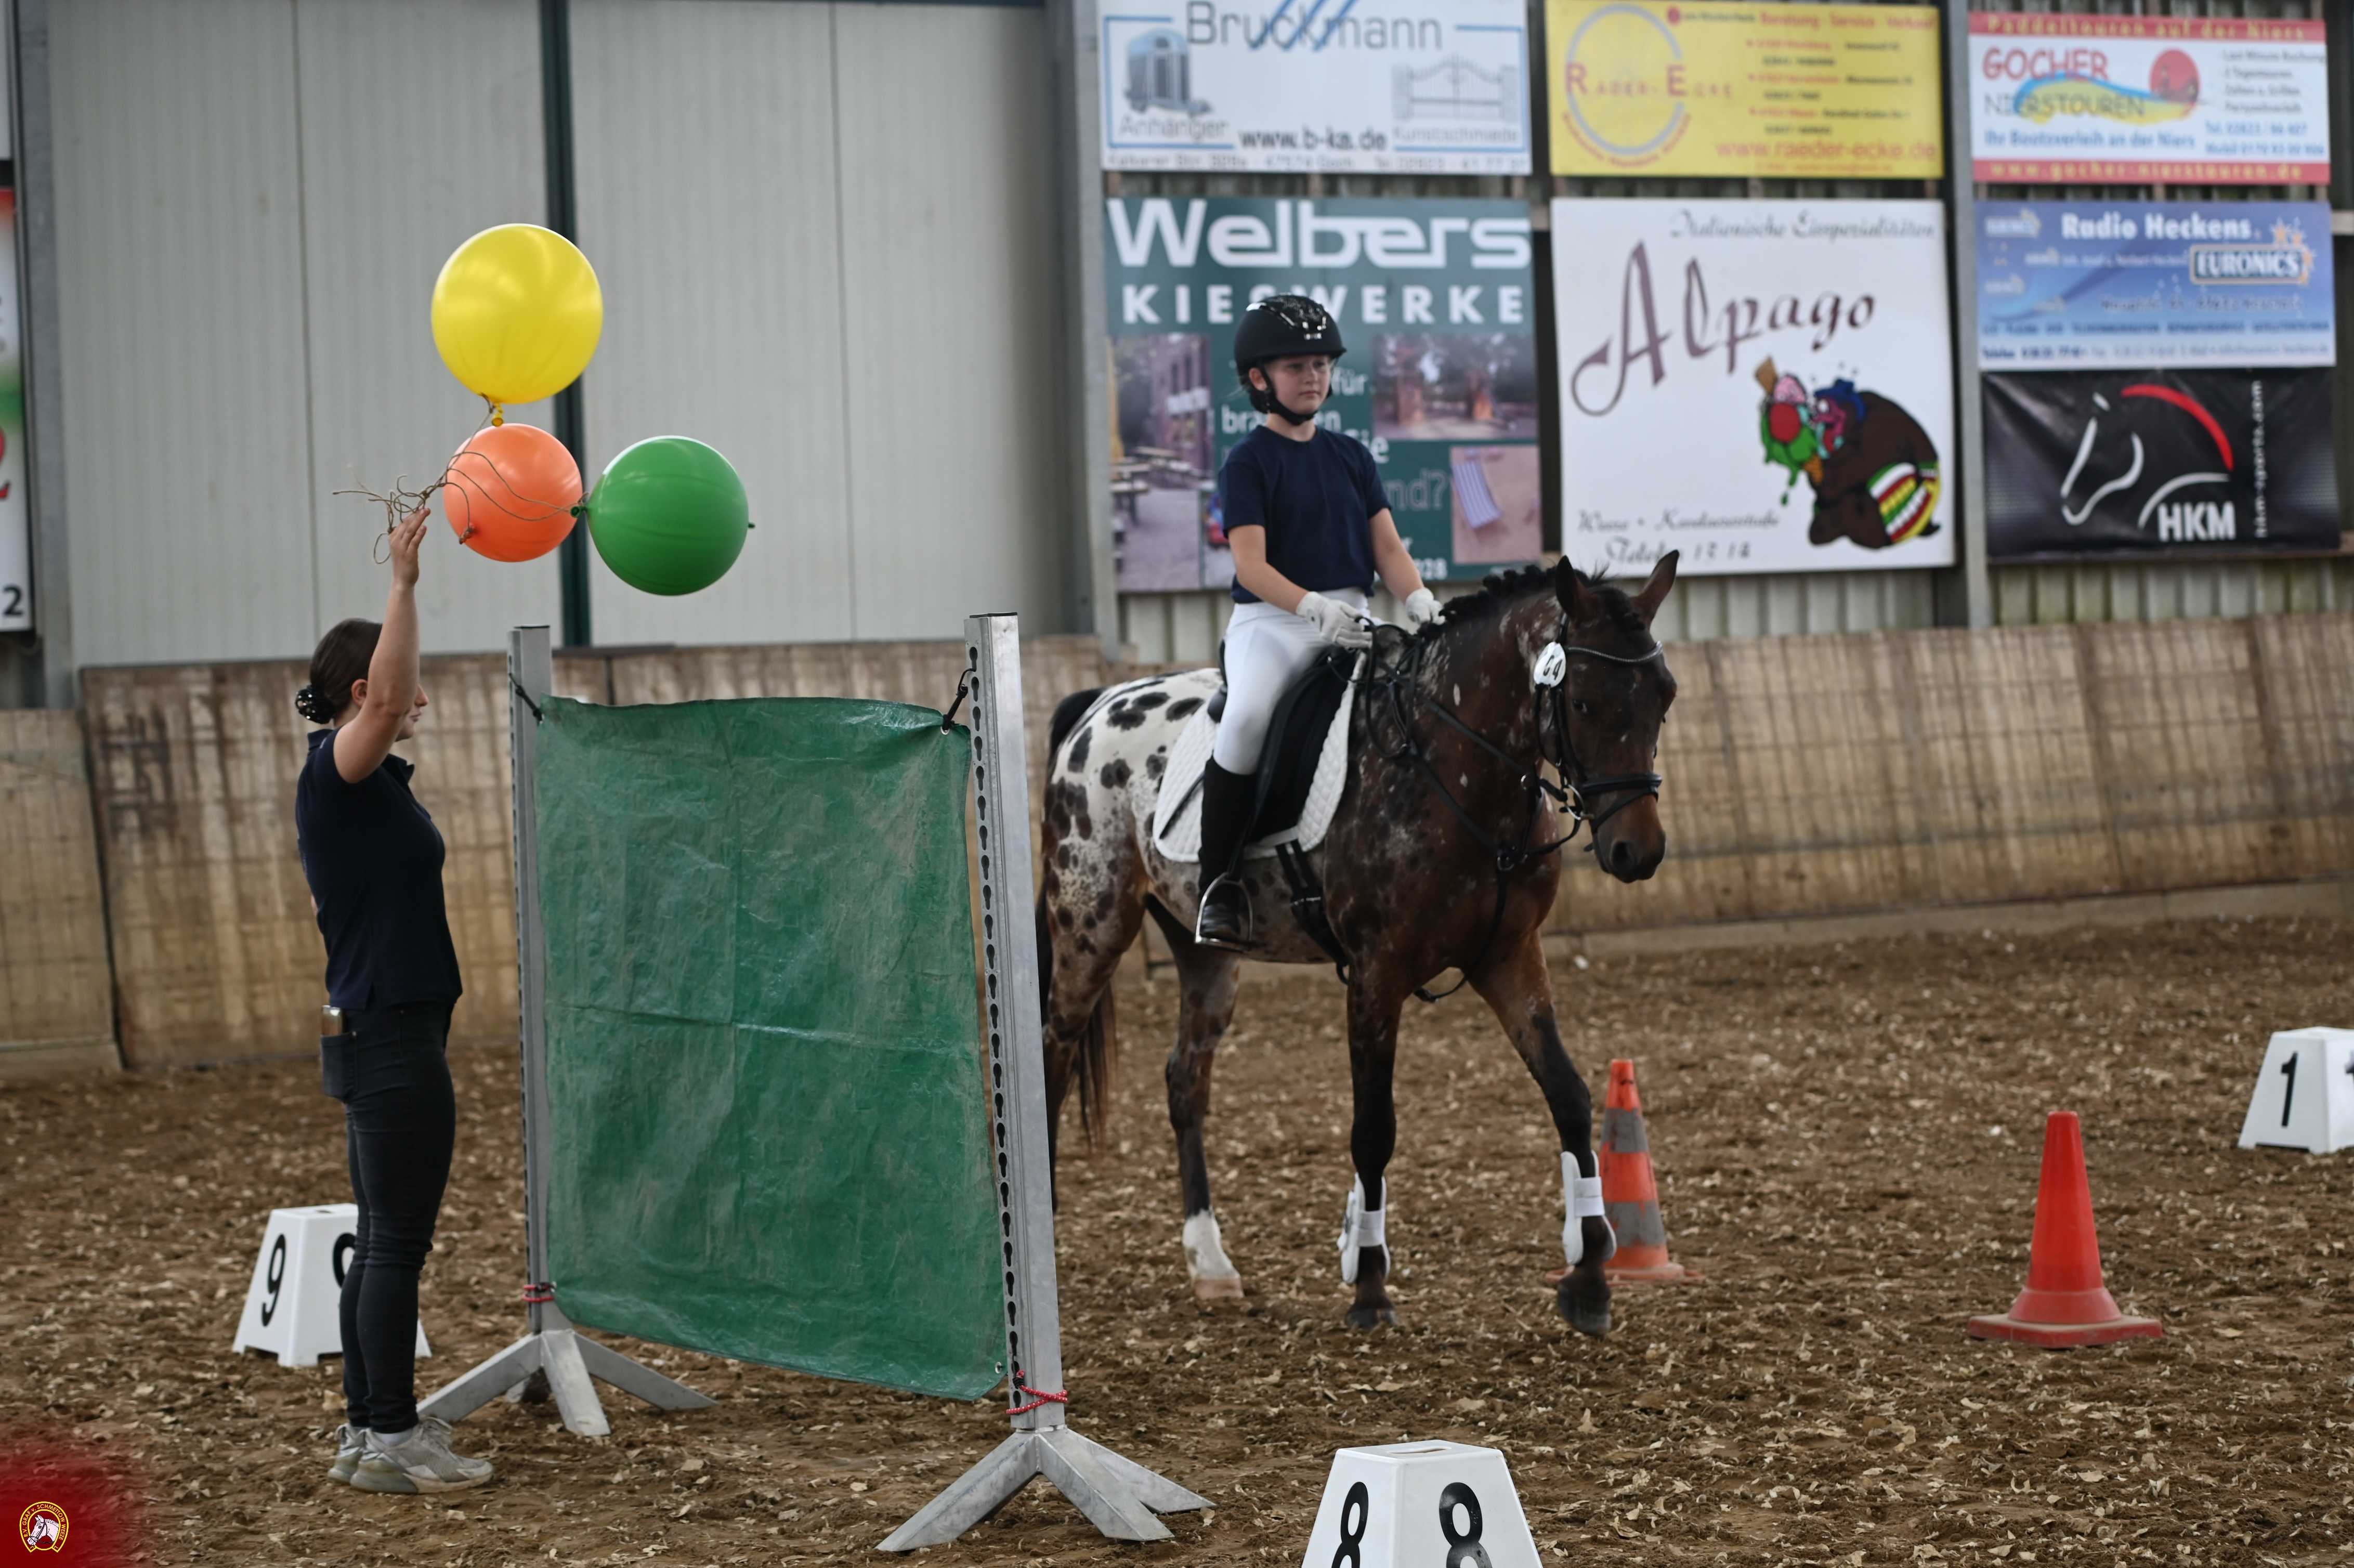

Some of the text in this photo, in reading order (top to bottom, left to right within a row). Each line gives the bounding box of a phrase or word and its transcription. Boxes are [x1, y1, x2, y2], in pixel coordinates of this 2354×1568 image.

[1988, 16, 2304, 39] Paddeltouren auf der Niers
[1982, 47, 2109, 81] GOCHER
[1984, 93, 2146, 119] NIERSTOUREN
[1237, 127, 1388, 151] www.b-ka.de
[1991, 163, 2302, 181] www.gocher-nierstouren.de
[1107, 198, 1532, 269] Welbers
[2061, 212, 2137, 240] Radio
[2145, 213, 2252, 240] Heckens
[2196, 249, 2302, 278] EURONICS
[1571, 240, 1876, 417] Alpago
[1331, 367, 1367, 396] für
[1221, 404, 1341, 434] braen
[1383, 467, 1447, 511] nd?
[2157, 502, 2235, 542] HKM
[2281, 1050, 2298, 1128] 1
[261, 1234, 286, 1327] 9
[1331, 1481, 1369, 1568] 8
[1438, 1482, 1493, 1568] 8
